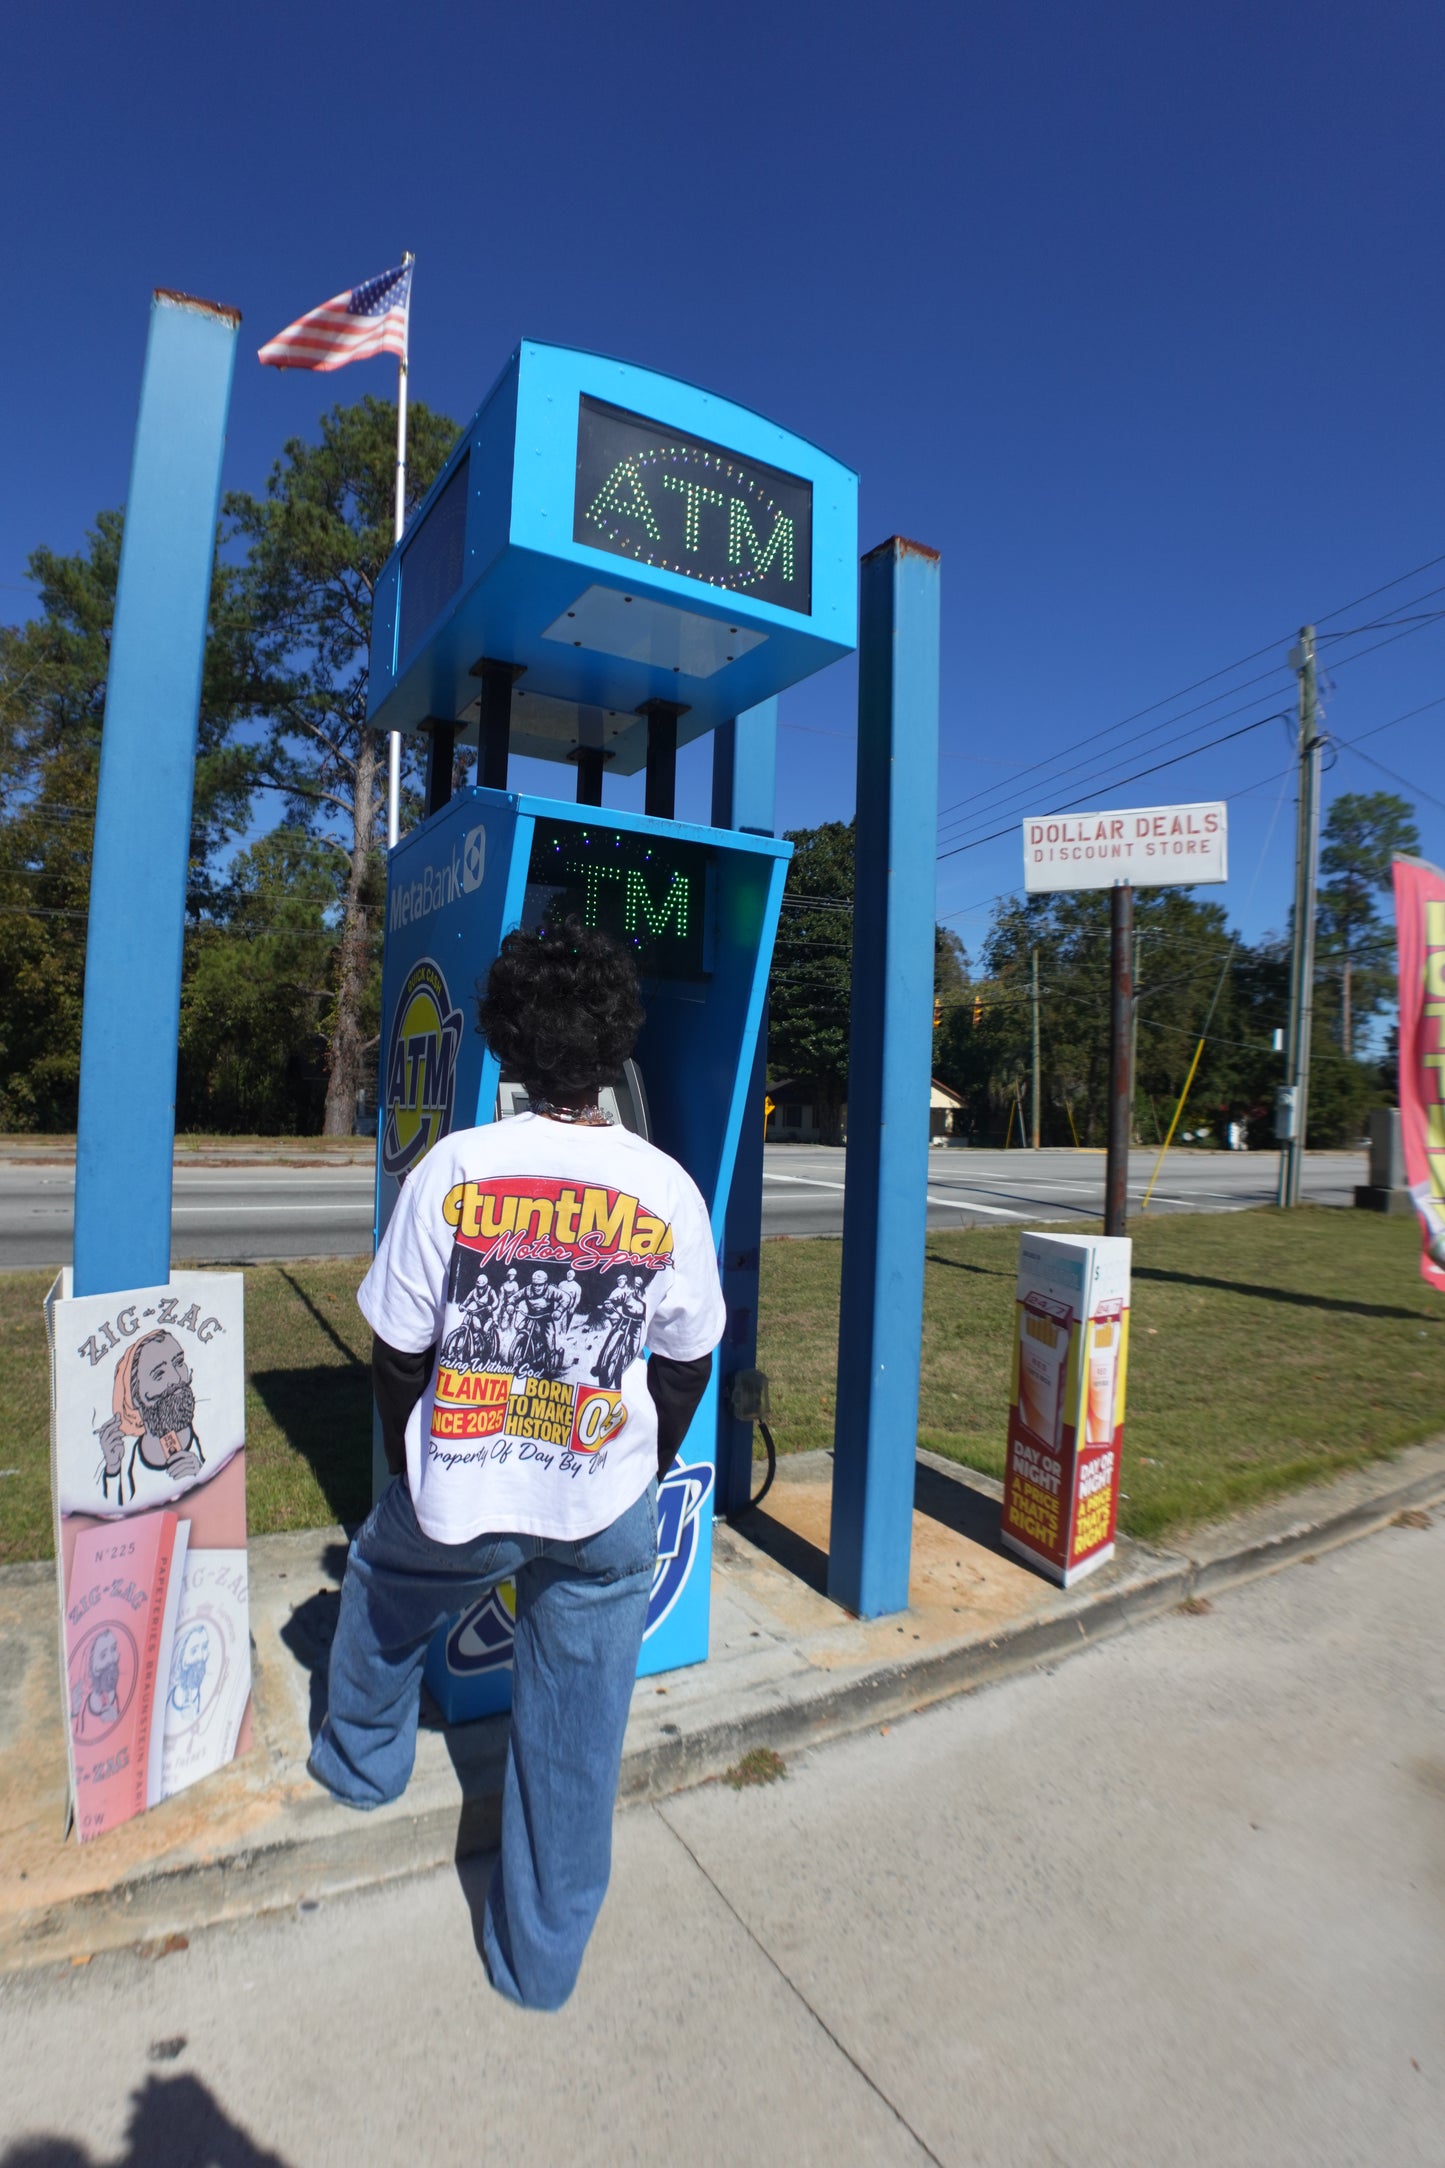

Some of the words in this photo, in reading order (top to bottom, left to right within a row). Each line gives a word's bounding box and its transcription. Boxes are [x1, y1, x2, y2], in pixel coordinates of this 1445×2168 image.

[585, 462, 794, 582] ATM
[1031, 819, 1124, 845] DOLLAR
[1136, 813, 1219, 839] DEALS
[1034, 843, 1135, 863] DISCOUNT
[1146, 839, 1212, 856] STORE
[390, 843, 461, 934] MetaBank
[565, 861, 688, 937] TM
[408, 968, 426, 993] QUICK
[426, 968, 442, 997] CASH
[387, 1027, 453, 1109] ATM
[480, 1229, 572, 1268] Motor
[1029, 1296, 1065, 1314] 24/7
[78, 1298, 222, 1367] ZIG-ZAG
[436, 1371, 508, 1402] TLANTA
[471, 1358, 515, 1374] Without
[518, 1362, 545, 1379] God
[525, 1378, 574, 1405] BORN
[432, 1409, 464, 1434] NCE
[466, 1409, 503, 1433] 2025
[509, 1395, 528, 1416] TO
[530, 1398, 574, 1427] MAKE
[505, 1415, 571, 1447] HISTORY
[490, 1439, 513, 1464] Of
[518, 1442, 554, 1471] Day
[559, 1452, 582, 1479] By
[1013, 1454, 1061, 1495] NIGHT
[1014, 1440, 1040, 1465] DAY
[1042, 1456, 1061, 1480] OR
[1080, 1457, 1101, 1480] DAY
[1101, 1451, 1115, 1471] OR
[1012, 1477, 1021, 1491] A
[1024, 1482, 1060, 1514] PRICE
[1078, 1466, 1114, 1500] NIGHT
[1078, 1501, 1087, 1517] A
[1087, 1485, 1112, 1513] PRICE
[1009, 1505, 1058, 1549] RIGHT
[1011, 1490, 1058, 1531] THAT'S
[1076, 1503, 1111, 1535] THAT'S
[1074, 1519, 1110, 1556] RIGHT
[68, 1578, 148, 1627] ZIG-ZAG
[183, 1565, 248, 1605] IG-ZAG
